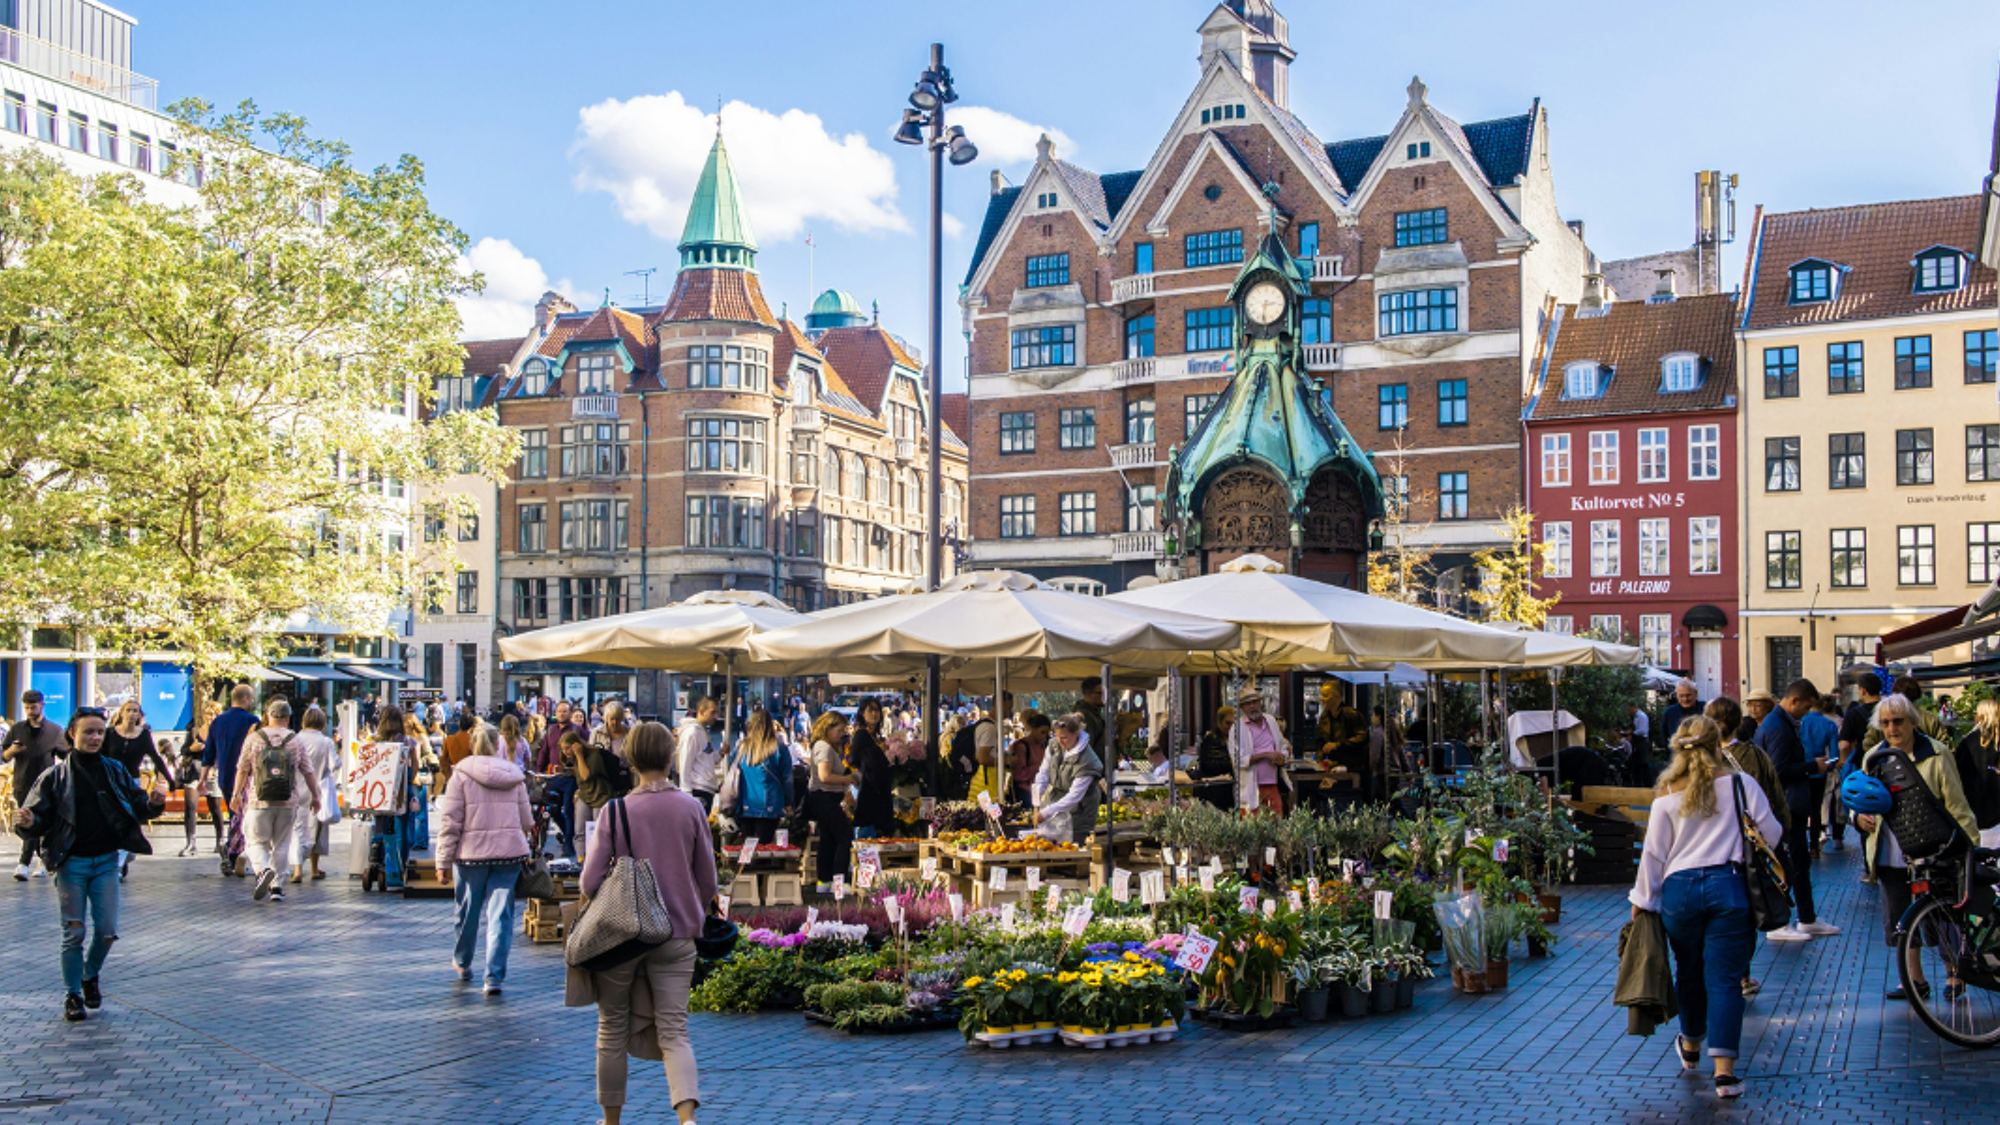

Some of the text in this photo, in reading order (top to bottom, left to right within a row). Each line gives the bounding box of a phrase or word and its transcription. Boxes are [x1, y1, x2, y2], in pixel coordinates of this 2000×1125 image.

[1570, 496, 1645, 511] Kultorvet
[1675, 492, 1685, 507] 5
[1590, 578, 1670, 595] CAFÉ PALERMO
[356, 780, 386, 809] 10
